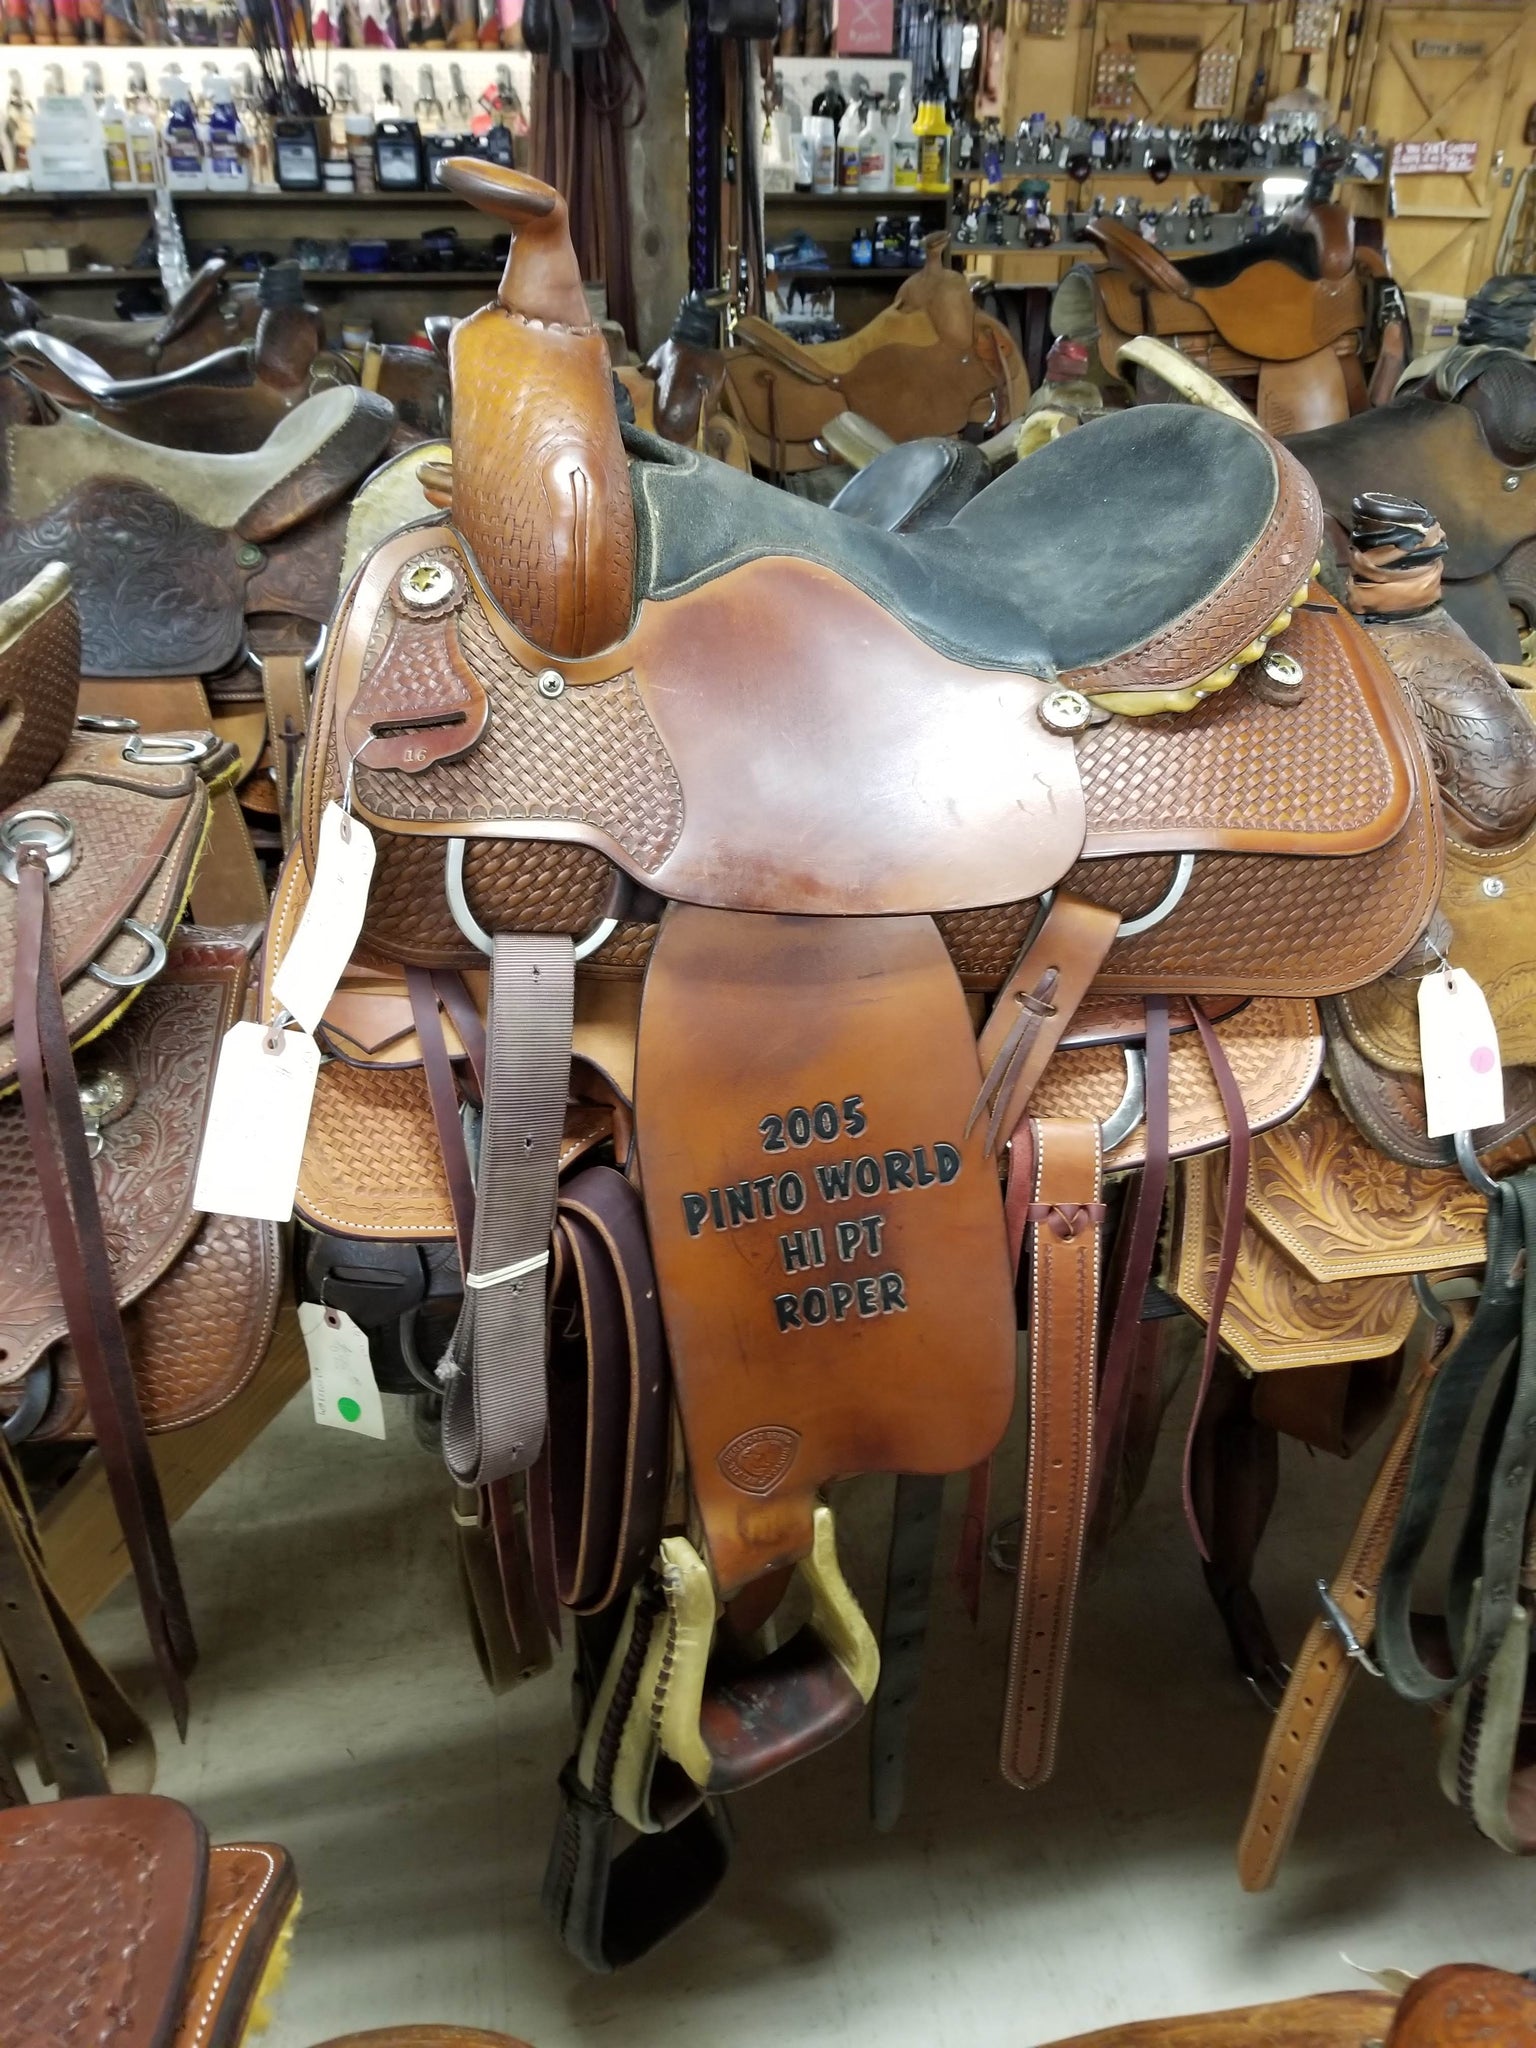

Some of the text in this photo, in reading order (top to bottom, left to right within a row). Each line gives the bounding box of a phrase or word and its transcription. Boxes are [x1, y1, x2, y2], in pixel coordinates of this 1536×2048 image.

[404, 748, 427, 762] 16
[759, 1095, 866, 1154] 2005
[681, 1142, 962, 1238] PINTO WORLD
[779, 1215, 885, 1275] HI PT
[773, 1272, 908, 1332] ROPER
